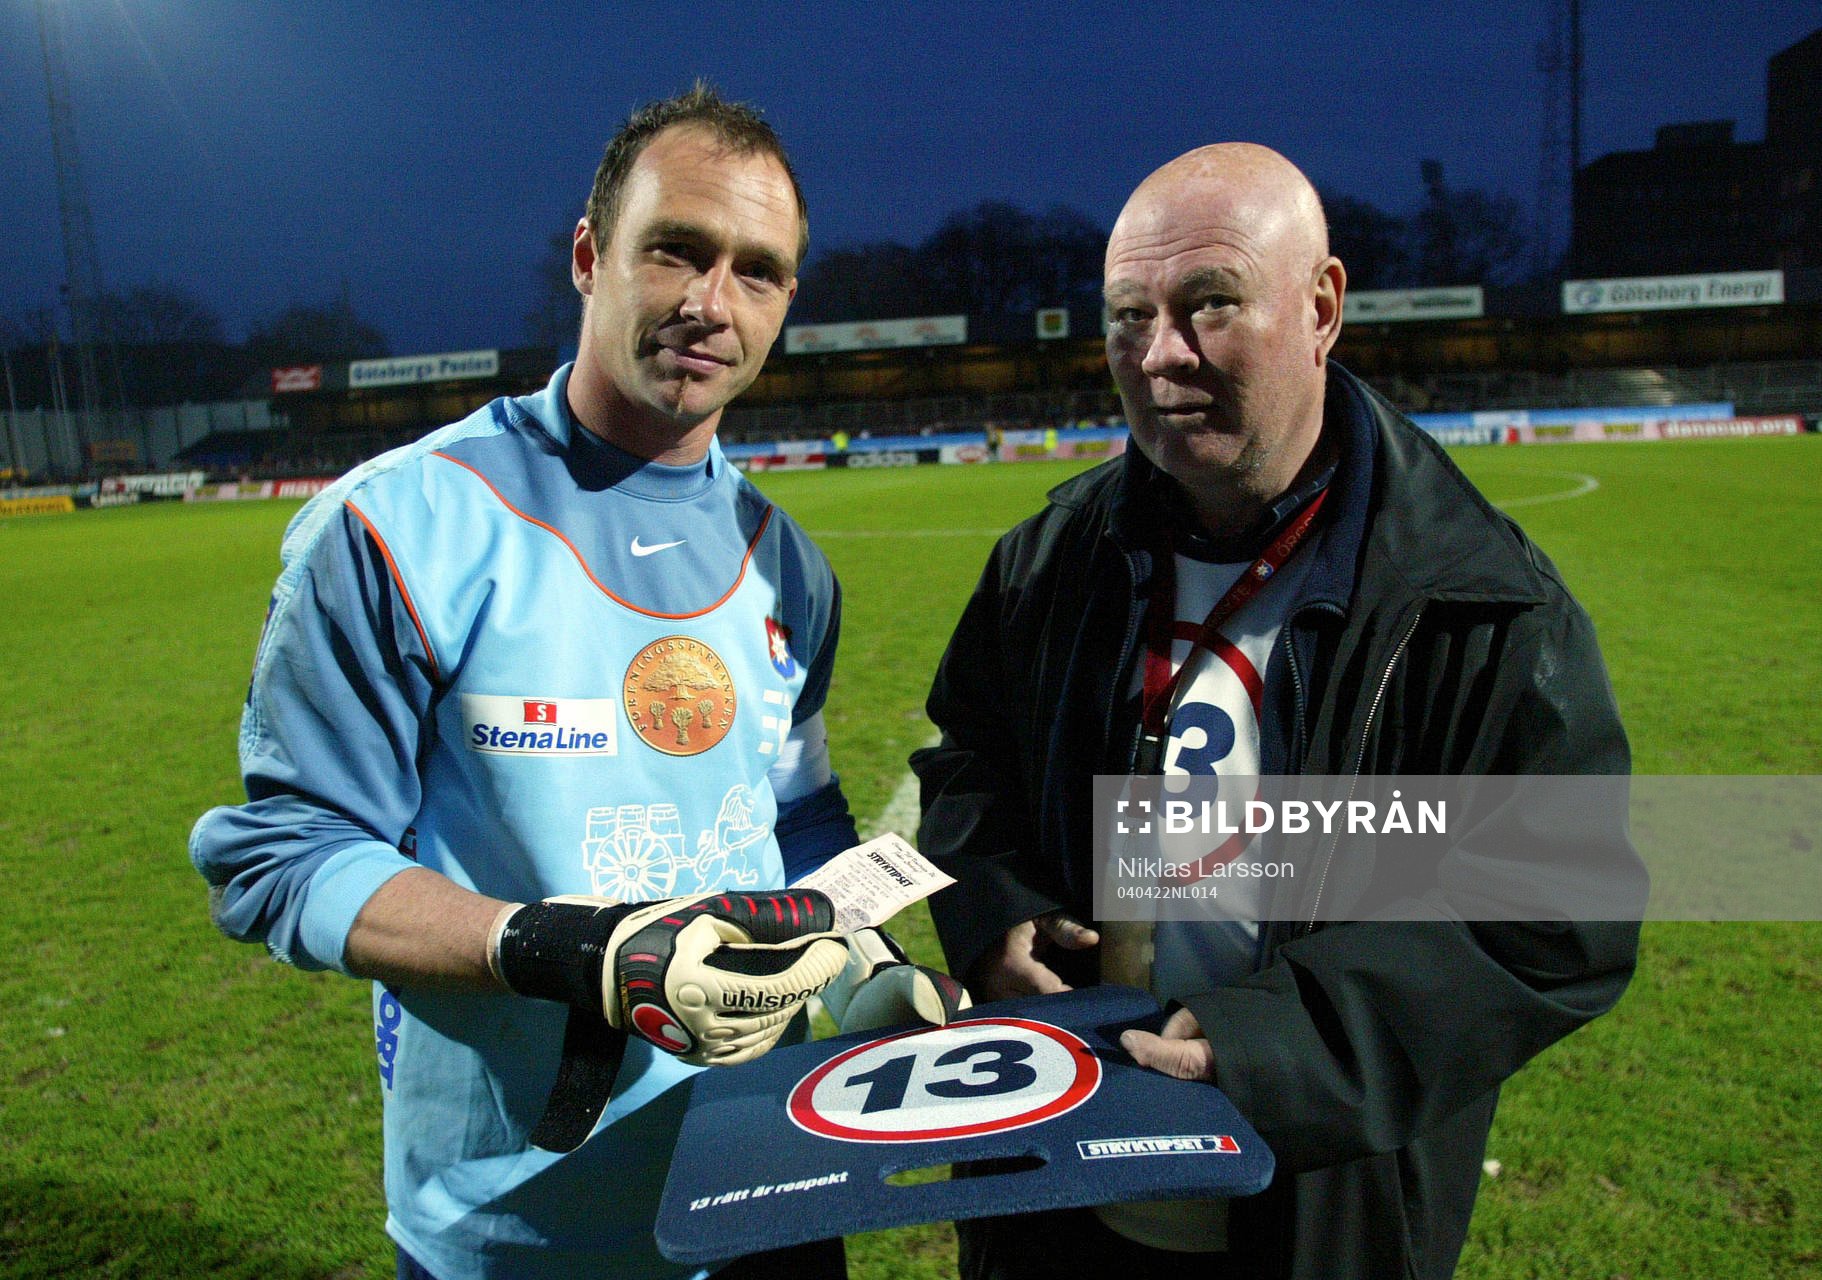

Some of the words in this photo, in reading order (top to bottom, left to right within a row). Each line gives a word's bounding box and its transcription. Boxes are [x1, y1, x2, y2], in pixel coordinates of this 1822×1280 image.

[536, 703, 548, 722] S
[866, 851, 914, 888] STRYKTIPSET
[722, 976, 831, 1009] uhlsport
[843, 1039, 1037, 1115] 13
[1086, 1138, 1204, 1156] STRYKTIPSET
[689, 1197, 712, 1211] 13
[711, 1188, 751, 1206] rätt
[751, 1184, 775, 1198] är
[775, 1171, 849, 1193] respekt
